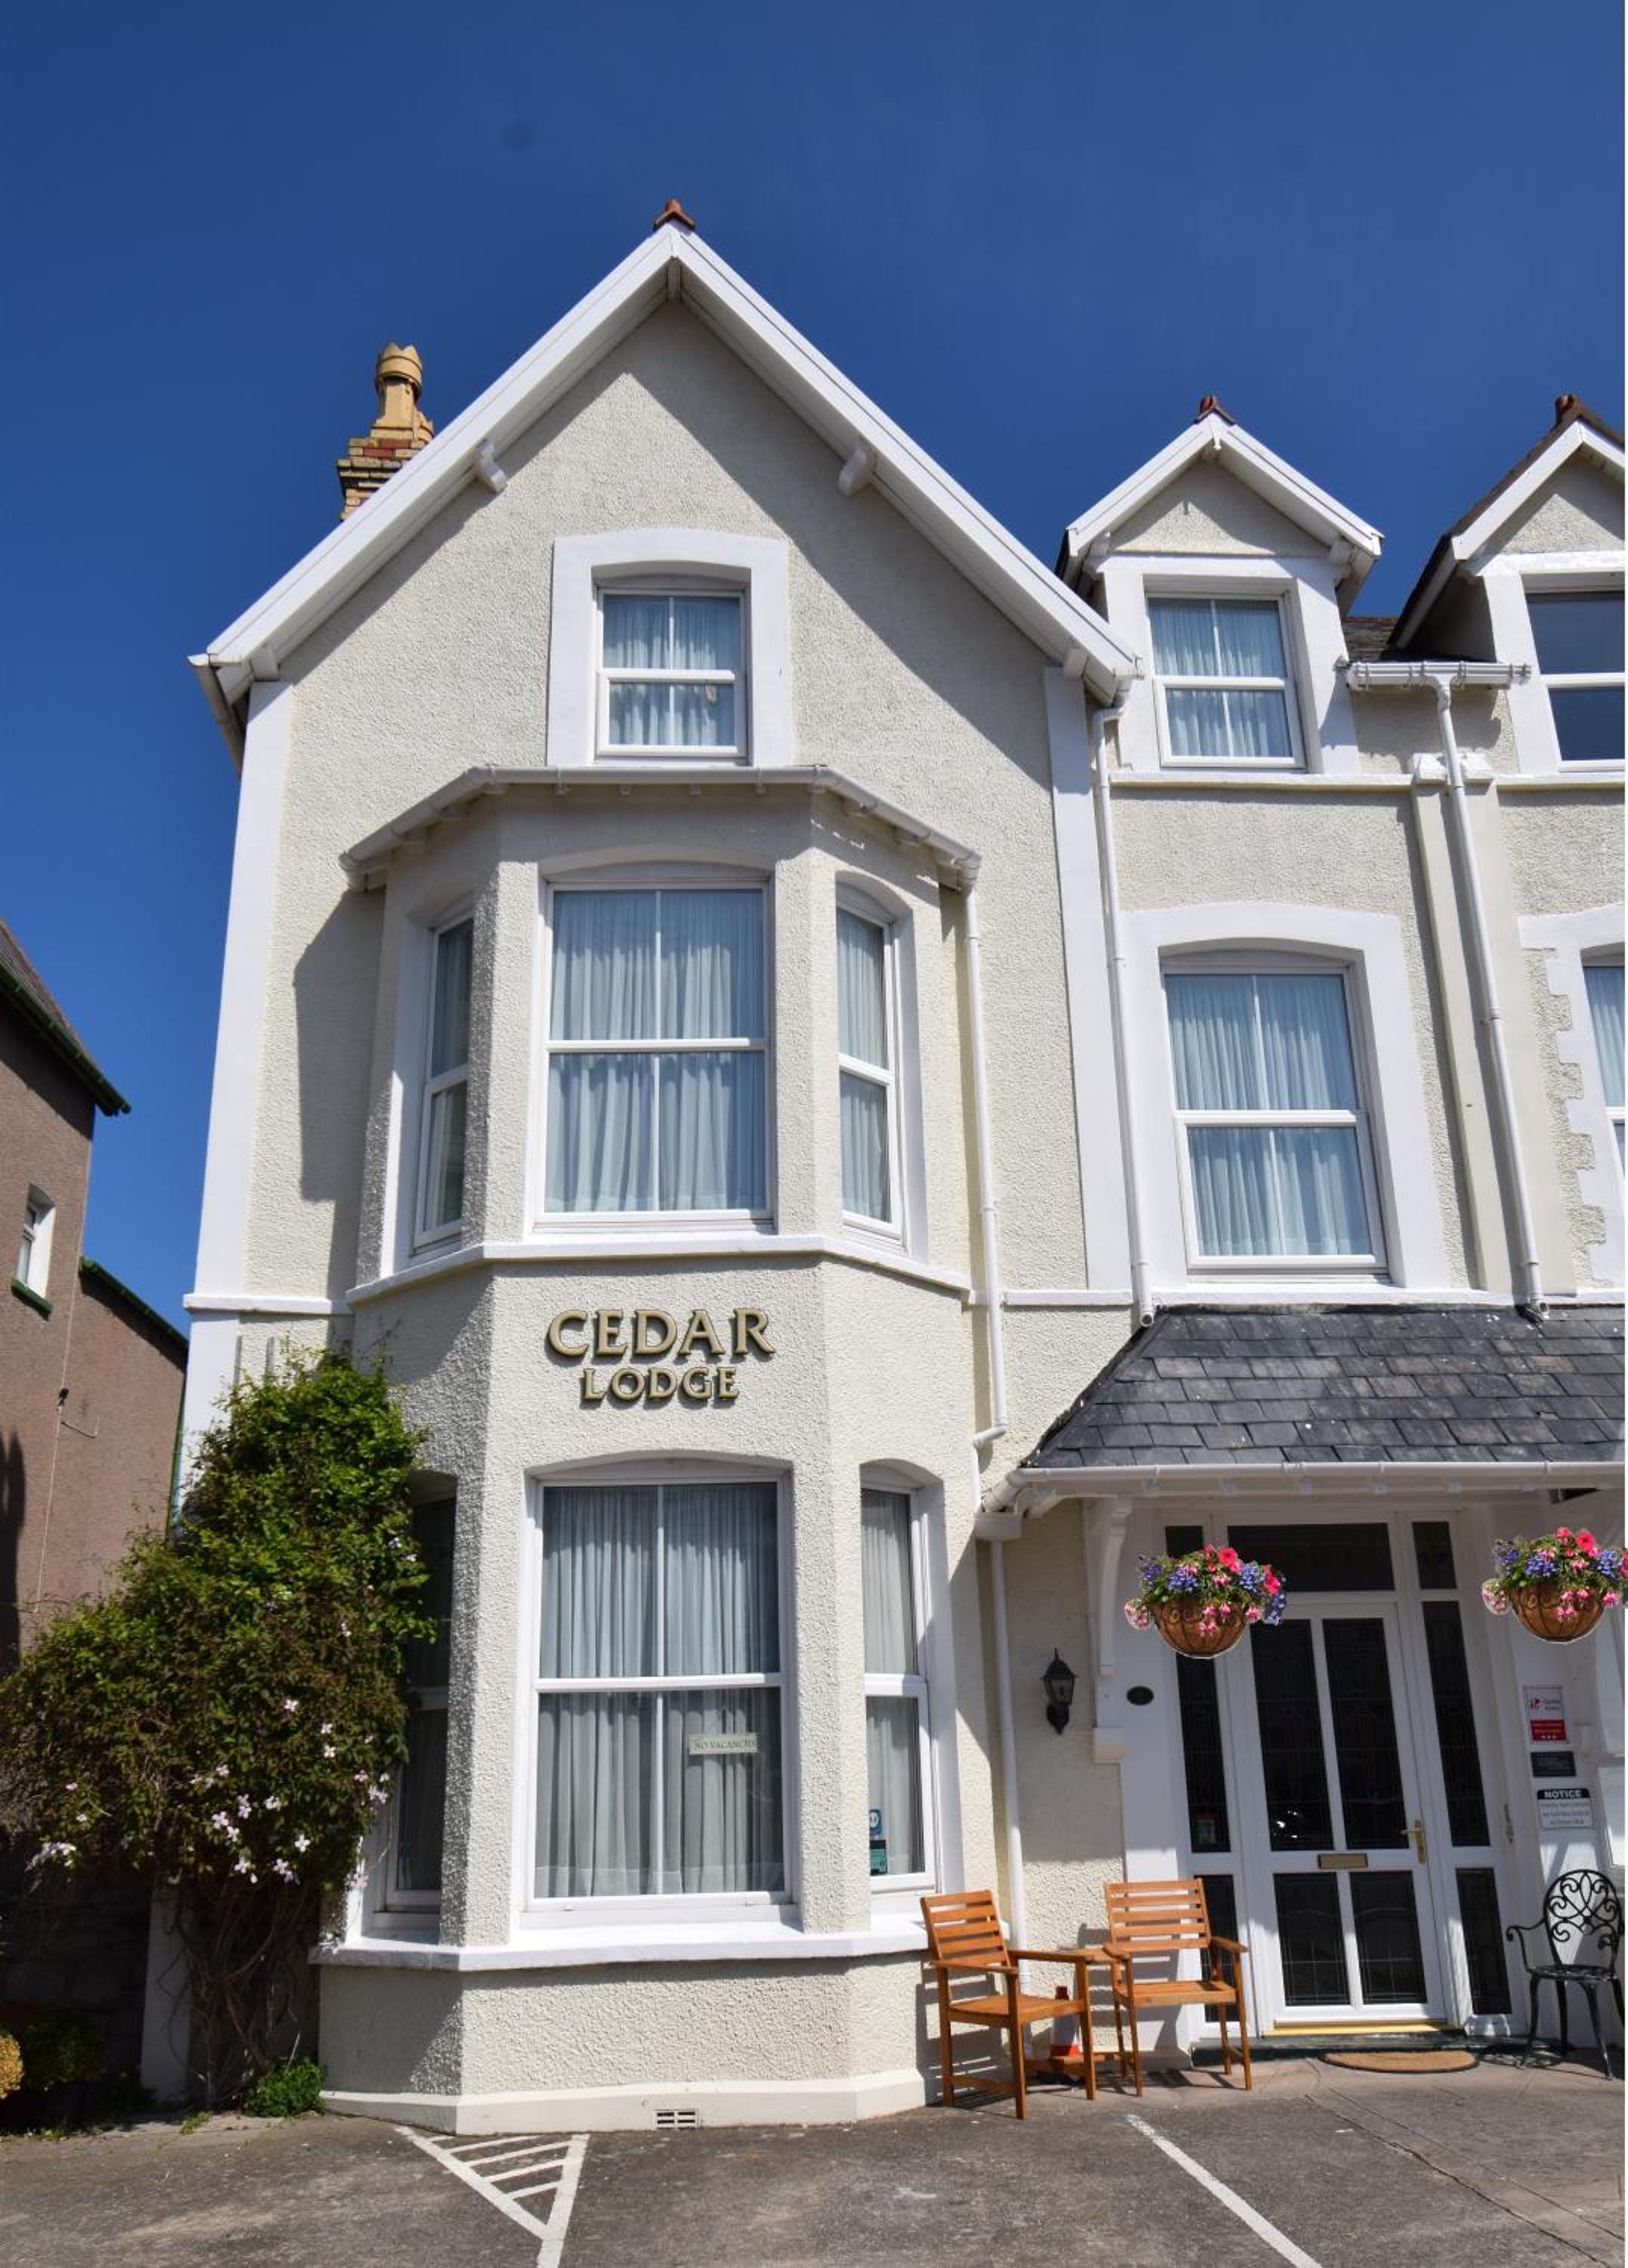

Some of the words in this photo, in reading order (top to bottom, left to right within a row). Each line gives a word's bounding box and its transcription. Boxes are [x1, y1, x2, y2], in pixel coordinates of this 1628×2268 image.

[548, 1308, 775, 1356] CEDAR
[583, 1366, 740, 1400] LODGE
[1544, 1789, 1582, 1799] NOTICE
